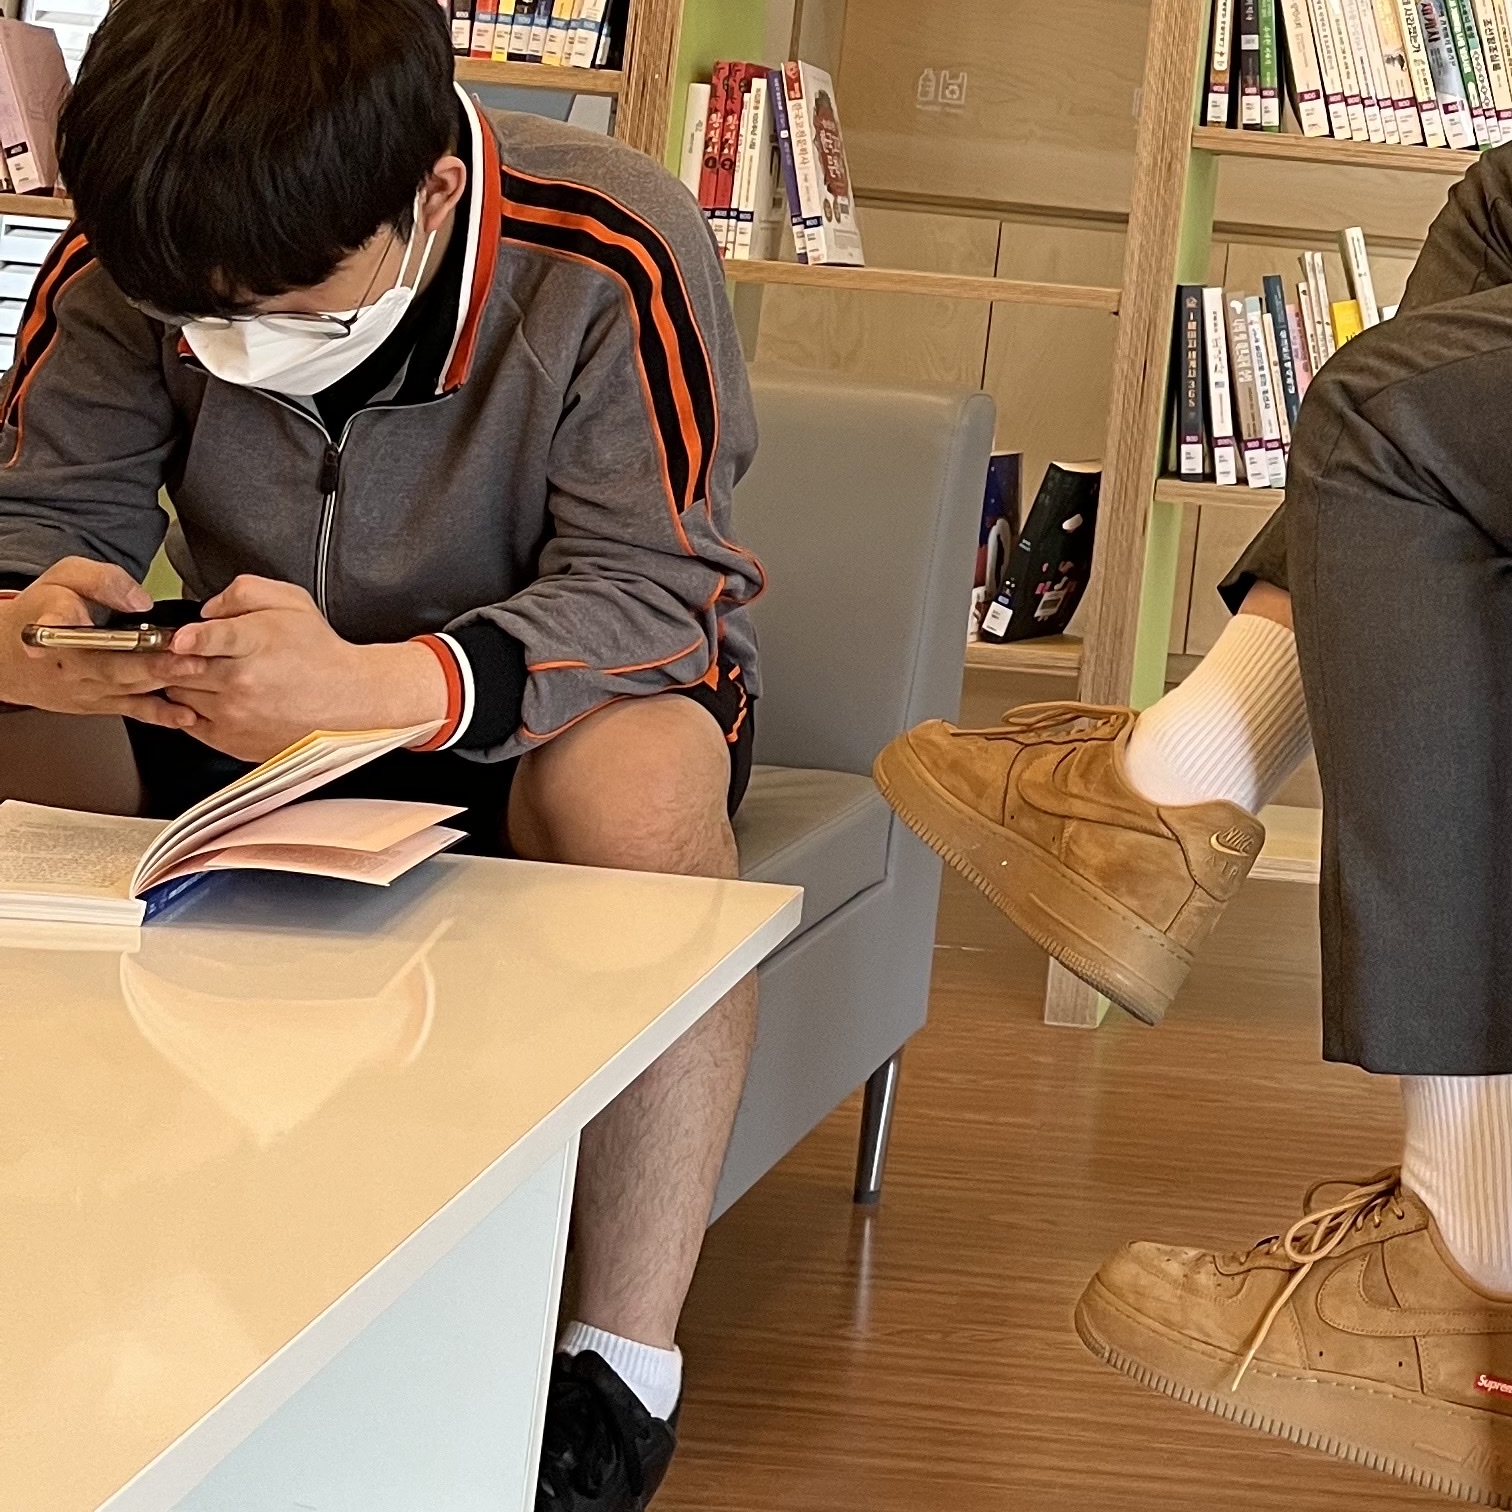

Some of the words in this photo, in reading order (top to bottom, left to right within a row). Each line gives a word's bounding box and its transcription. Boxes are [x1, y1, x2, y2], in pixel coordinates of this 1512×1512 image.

[1404, 6, 1423, 53] 사라졌는가
[1420, 2, 1441, 43] 세계사
[1223, 825, 1254, 854] NIKE
